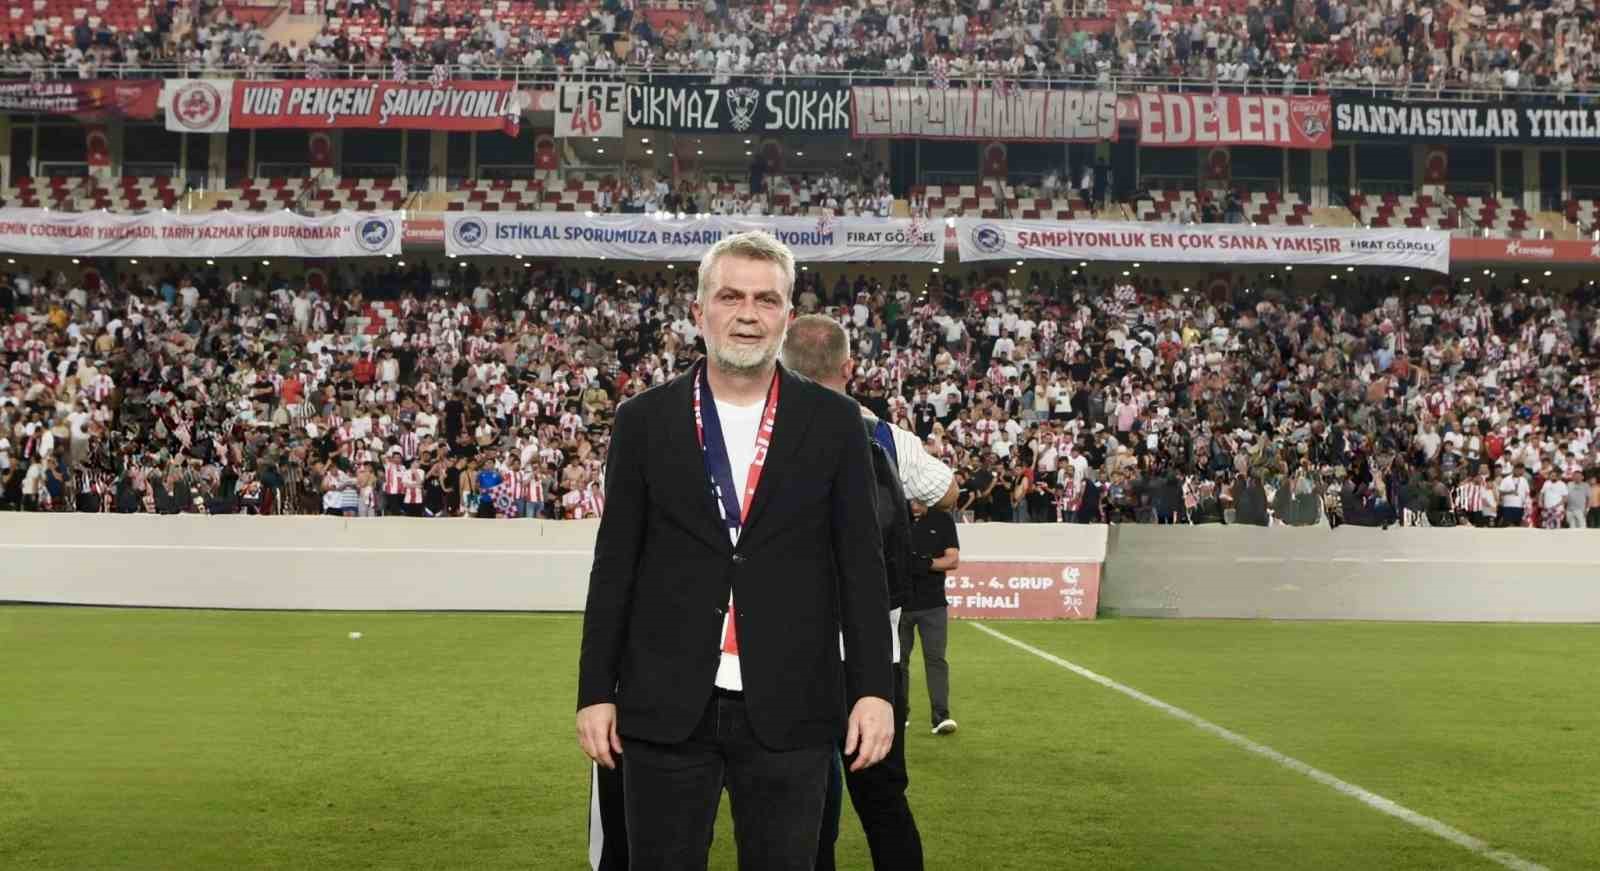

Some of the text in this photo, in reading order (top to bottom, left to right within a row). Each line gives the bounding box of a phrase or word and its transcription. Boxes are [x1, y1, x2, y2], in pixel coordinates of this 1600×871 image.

[242, 87, 284, 115] VUR
[287, 83, 379, 124] PENÇENİ
[764, 89, 850, 130] SOKAK
[1138, 93, 1291, 143] EDELER
[1336, 103, 1600, 138] SANMASINLAR YIKIL
[197, 225, 243, 239] YAZMAK
[246, 222, 270, 240] İÇİN
[495, 222, 560, 240] İSTİKLAL
[564, 225, 658, 244] SPORUMUZA
[662, 229, 743, 247] BAŞARIL
[847, 231, 882, 242] FIRAT
[885, 229, 937, 243] GÖEL
[1017, 230, 1146, 248] ŞAMPİYONLUK
[1151, 233, 1174, 248] EN
[1178, 233, 1214, 252] ÇOK
[1220, 234, 1268, 250] SANA
[1272, 235, 1341, 254] YAKIŞIR
[1350, 239, 1383, 249] FIRAT
[960, 576, 974, 589] 3.
[988, 577, 1004, 589] 4.
[1008, 576, 1054, 589] GRUP
[966, 592, 1020, 608] FİNALİ
